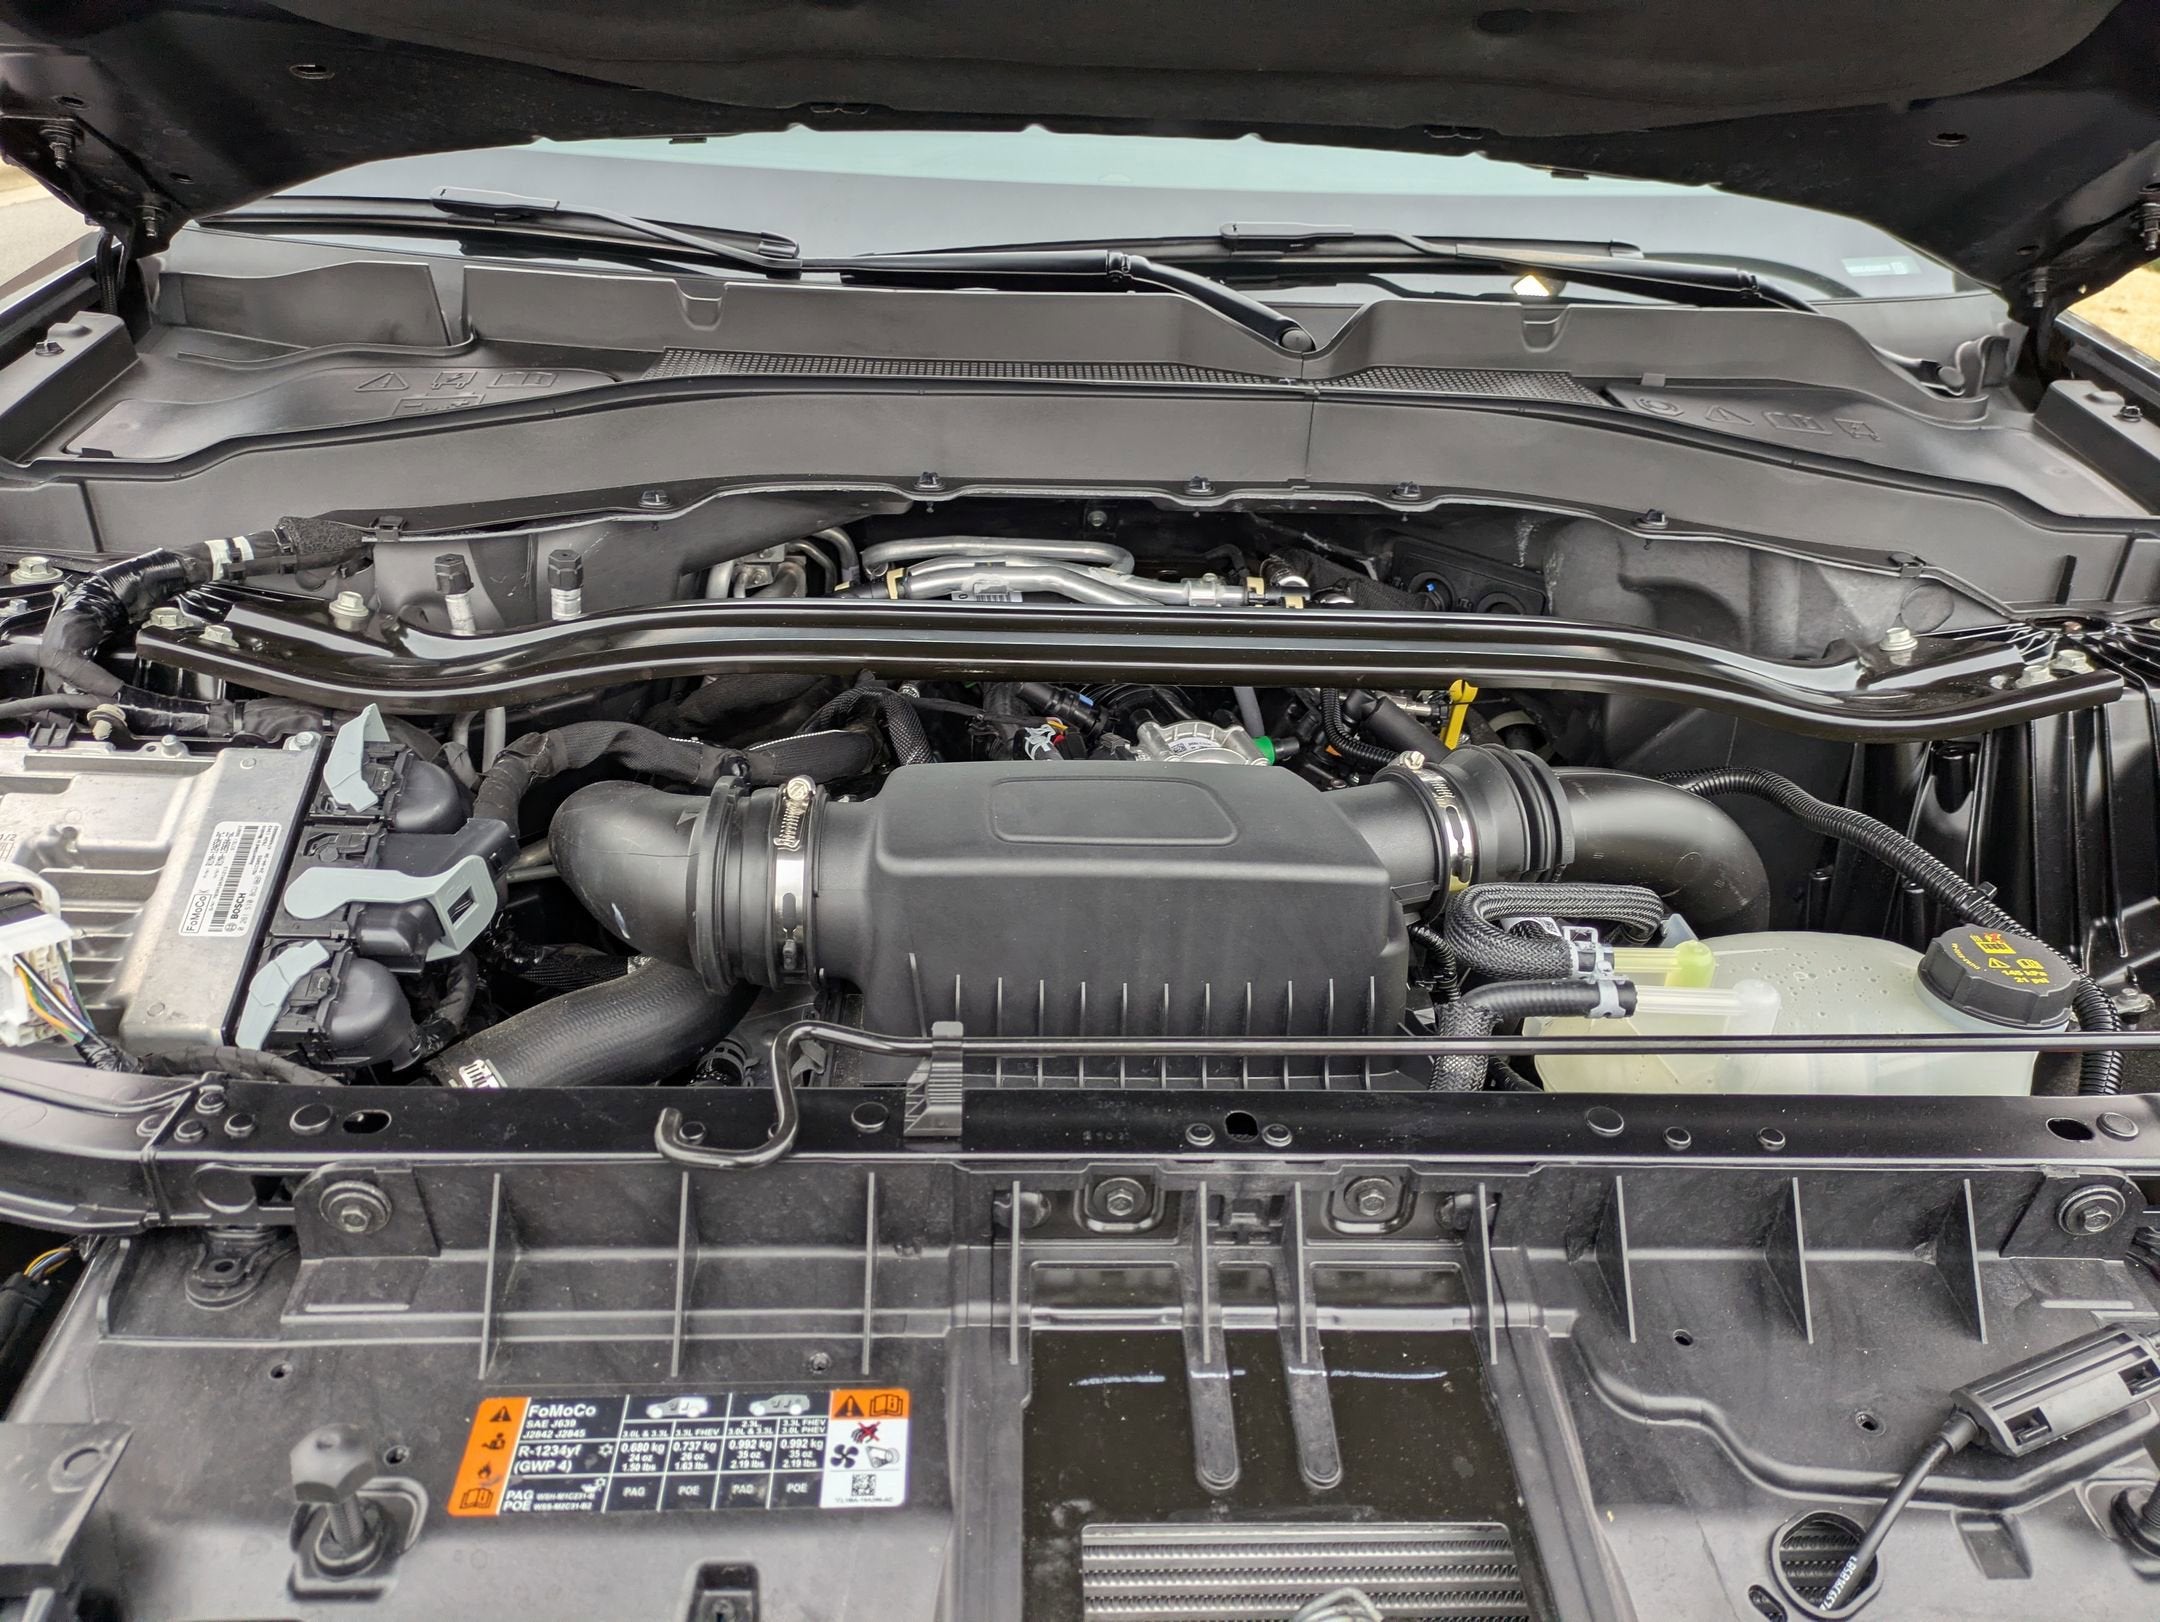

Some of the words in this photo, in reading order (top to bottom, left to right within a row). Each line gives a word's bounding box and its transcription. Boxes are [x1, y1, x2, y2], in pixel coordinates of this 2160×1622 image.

[230, 893, 247, 920] BOSCH
[186, 895, 207, 931] FoMoCo
[528, 1403, 597, 1418] FoMoCo
[526, 1420, 549, 1429] SAE
[650, 1442, 665, 1455] kg
[672, 1441, 701, 1452] 0.737
[702, 1440, 717, 1453] kg
[728, 1439, 757, 1450] 0.992
[758, 1439, 773, 1451] kg
[780, 1438, 809, 1449] 0.992
[809, 1438, 824, 1451] kg
[518, 1444, 582, 1458] R-1234yf
[694, 1452, 705, 1461] oz
[737, 1450, 748, 1459] 35
[749, 1451, 762, 1459] oz
[789, 1449, 800, 1458] 35
[801, 1450, 813, 1458] oz
[628, 1454, 640, 1462] 24
[641, 1454, 653, 1462] oz
[782, 1459, 802, 1468] 2.19
[802, 1459, 817, 1468] lbs
[514, 1460, 556, 1474] (GWP
[557, 1460, 573, 1473] 4)
[642, 1463, 656, 1471] lbs
[694, 1461, 708, 1470] lbs
[730, 1460, 750, 1469] 2.19
[751, 1460, 765, 1468] lbs
[622, 1486, 646, 1497] PAG
[678, 1485, 700, 1496] POE
[785, 1482, 808, 1493] POE
[506, 1489, 534, 1500] PAG
[503, 1500, 532, 1512] POE
